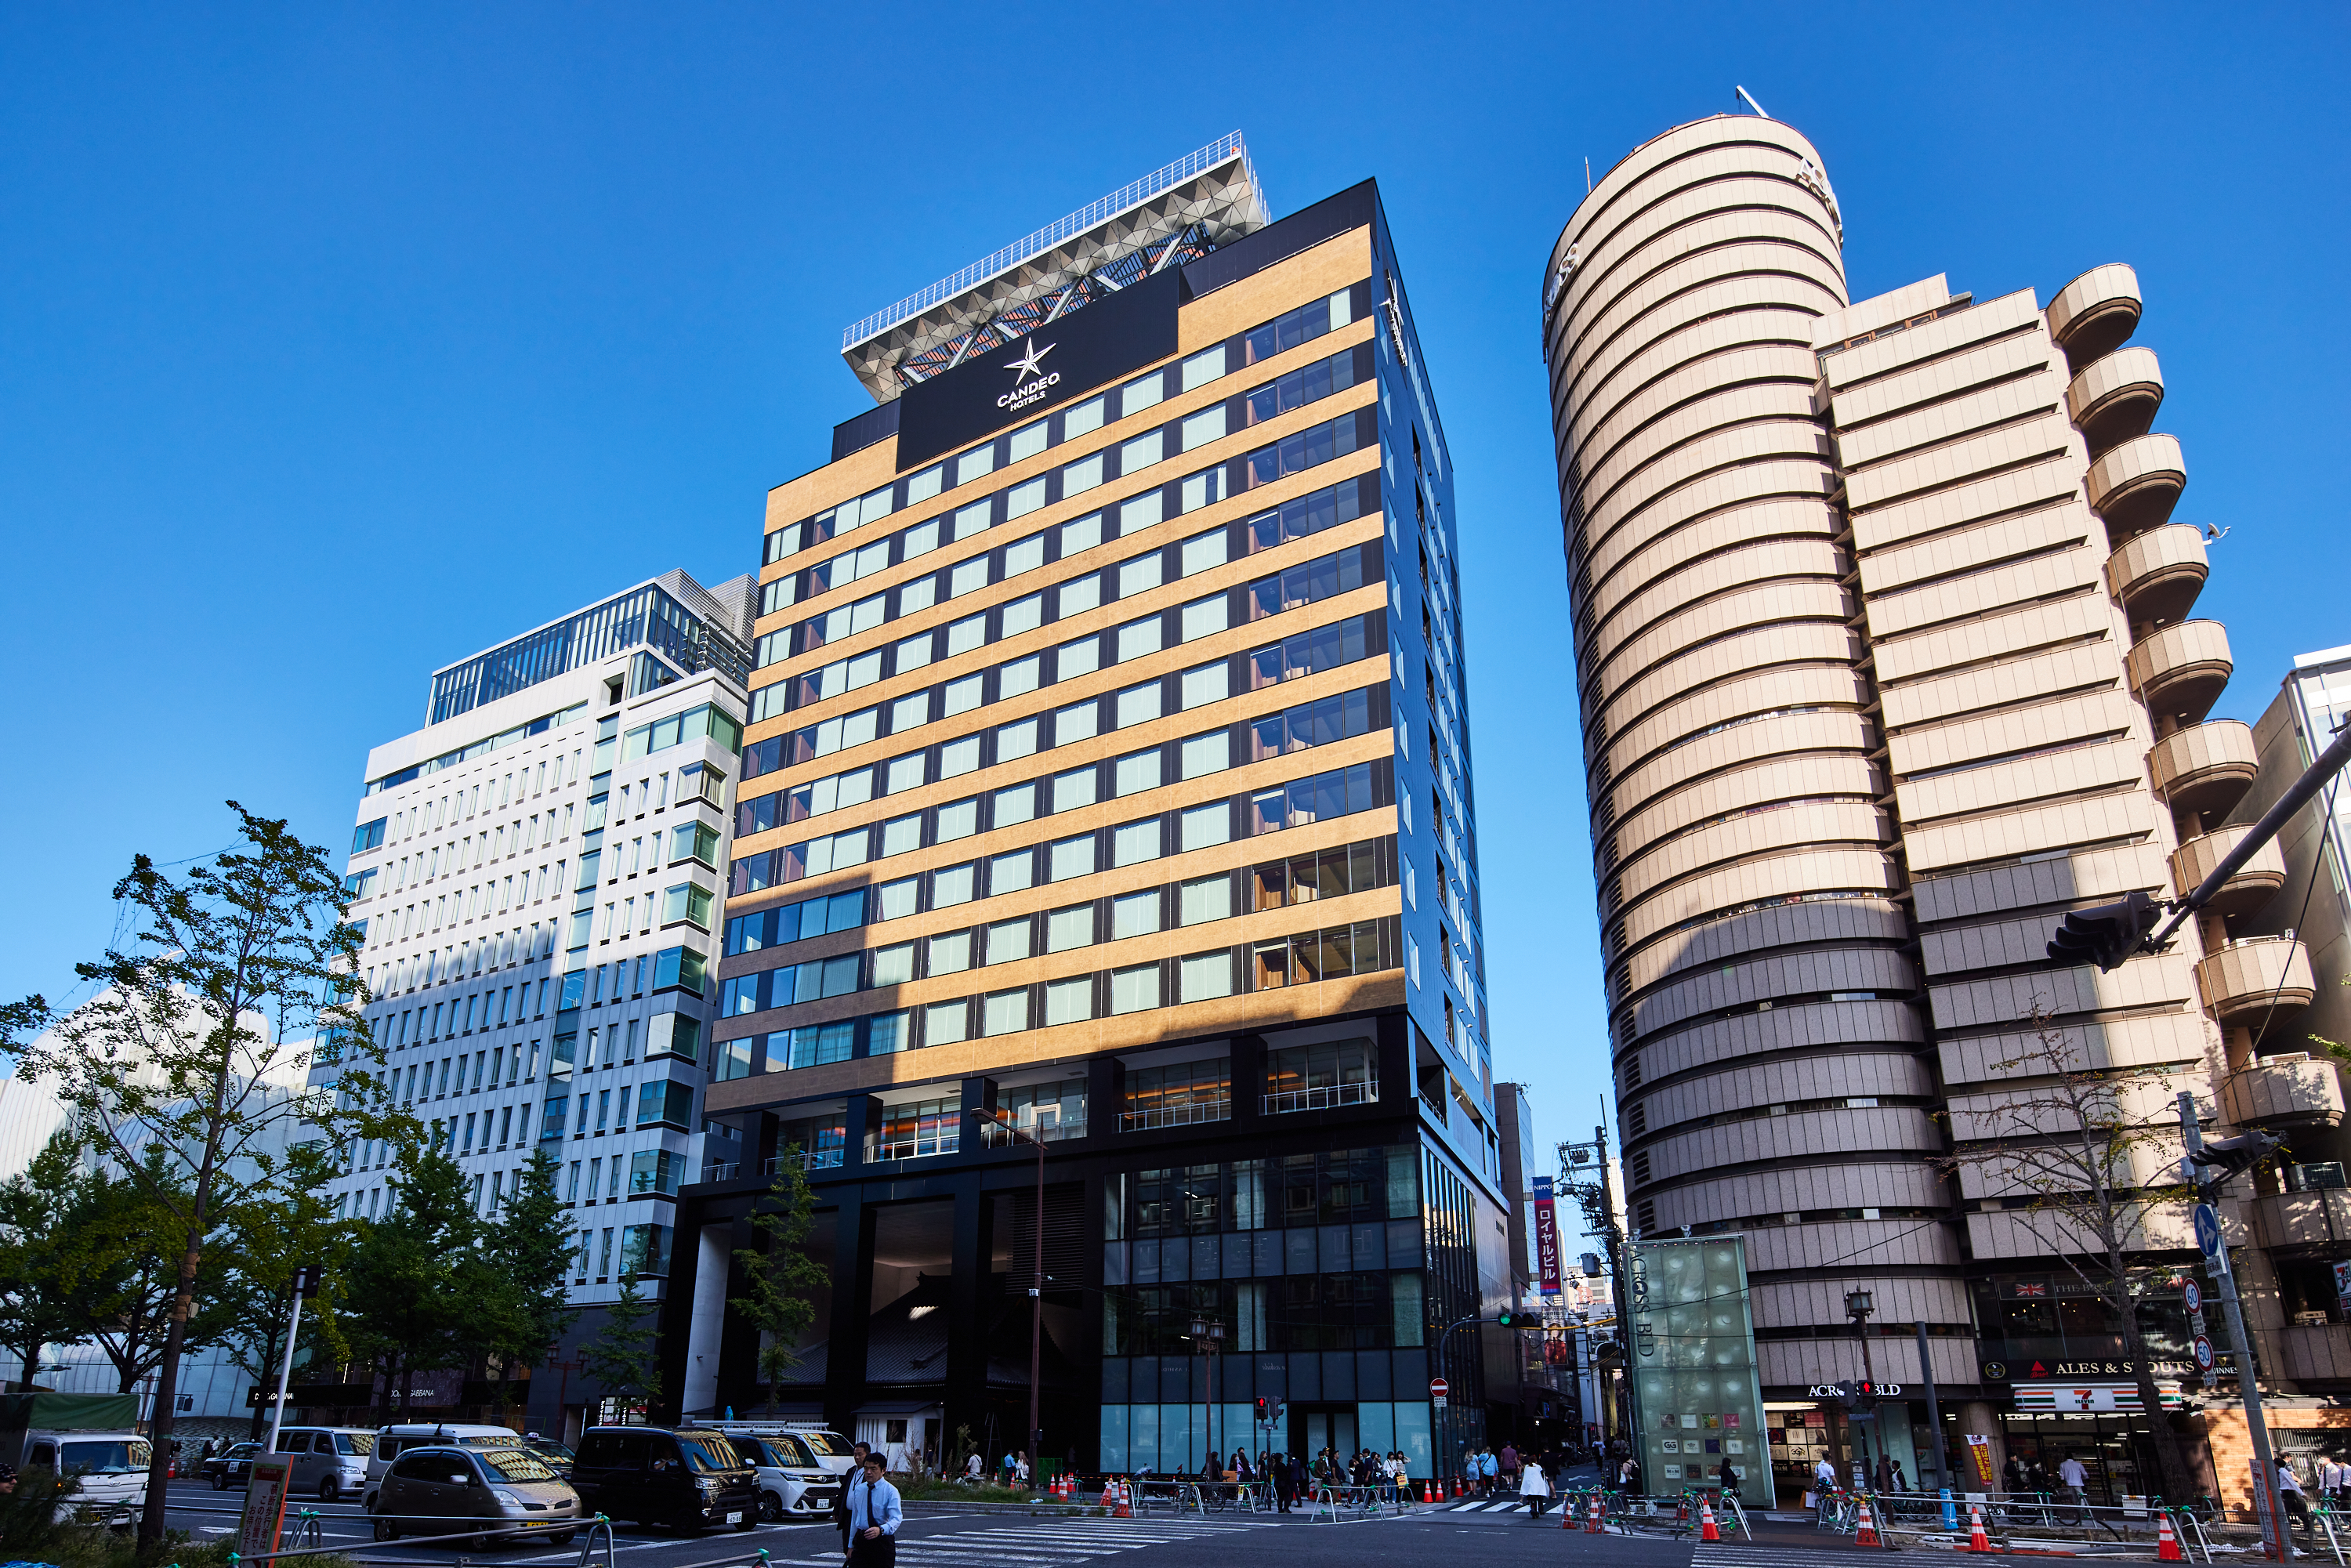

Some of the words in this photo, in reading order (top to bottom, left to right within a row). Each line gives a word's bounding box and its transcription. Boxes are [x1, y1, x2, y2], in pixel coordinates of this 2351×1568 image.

[997, 372, 1060, 407] CANDEO
[1010, 390, 1046, 412] HOTELS
[1539, 1209, 1556, 1280] ロイヤルビル
[1629, 1249, 1650, 1313] ACROSS
[2187, 1287, 2197, 1305] 60
[1636, 1322, 1654, 1357] BLD
[2198, 1345, 2210, 1362] 50
[2056, 1363, 2099, 1374] ALES
[2105, 1363, 2118, 1374] &
[2123, 1360, 2195, 1374] SOUTS
[252, 1495, 266, 1548] この位置で
[259, 1483, 279, 1549] 横断歩行者は
